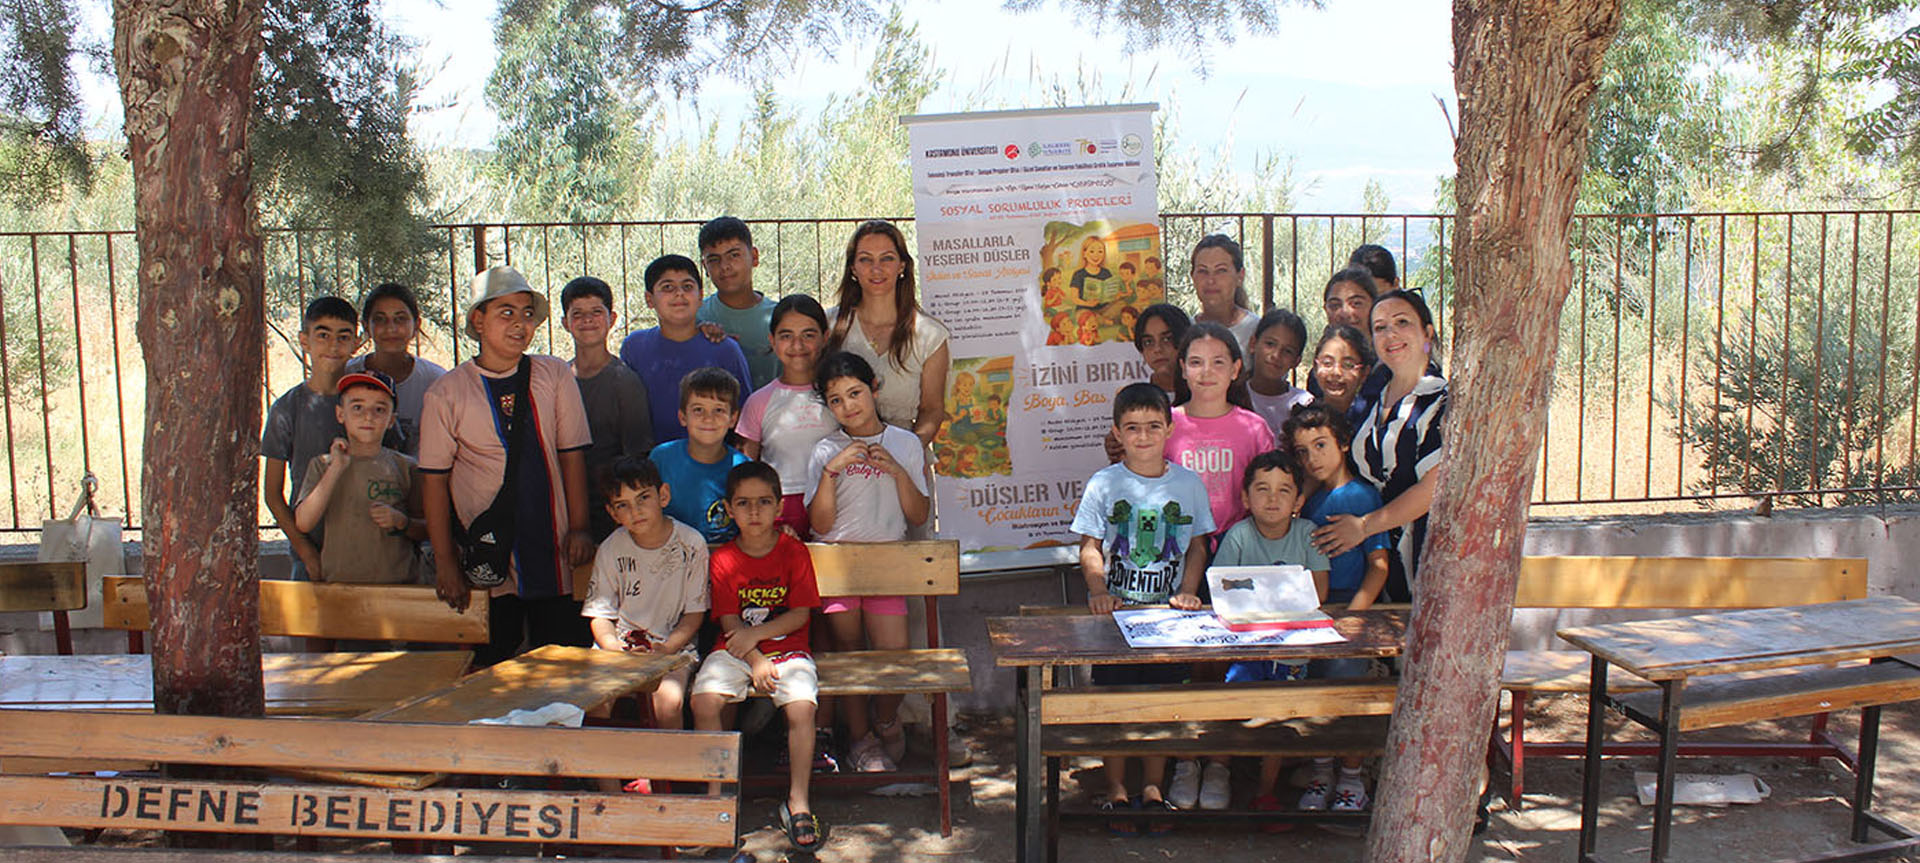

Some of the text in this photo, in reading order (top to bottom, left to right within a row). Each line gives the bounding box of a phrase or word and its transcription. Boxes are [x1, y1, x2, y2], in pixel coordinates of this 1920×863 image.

[941, 205, 982, 217] SOSYAL
[988, 200, 1061, 213] SORUMLULUK
[1067, 192, 1133, 208] PROJELERİ
[933, 235, 1015, 252] MASALLARLA
[924, 249, 1031, 267] YEŞEREN DÜŞLER
[1031, 360, 1149, 387] İZİNİ BIRAK
[1182, 448, 1233, 473] GOOD
[971, 480, 1083, 508] DÜŞLER VE
[738, 586, 788, 599] MICKEY
[100, 785, 582, 840] DEFNE BELEDİYESİ
